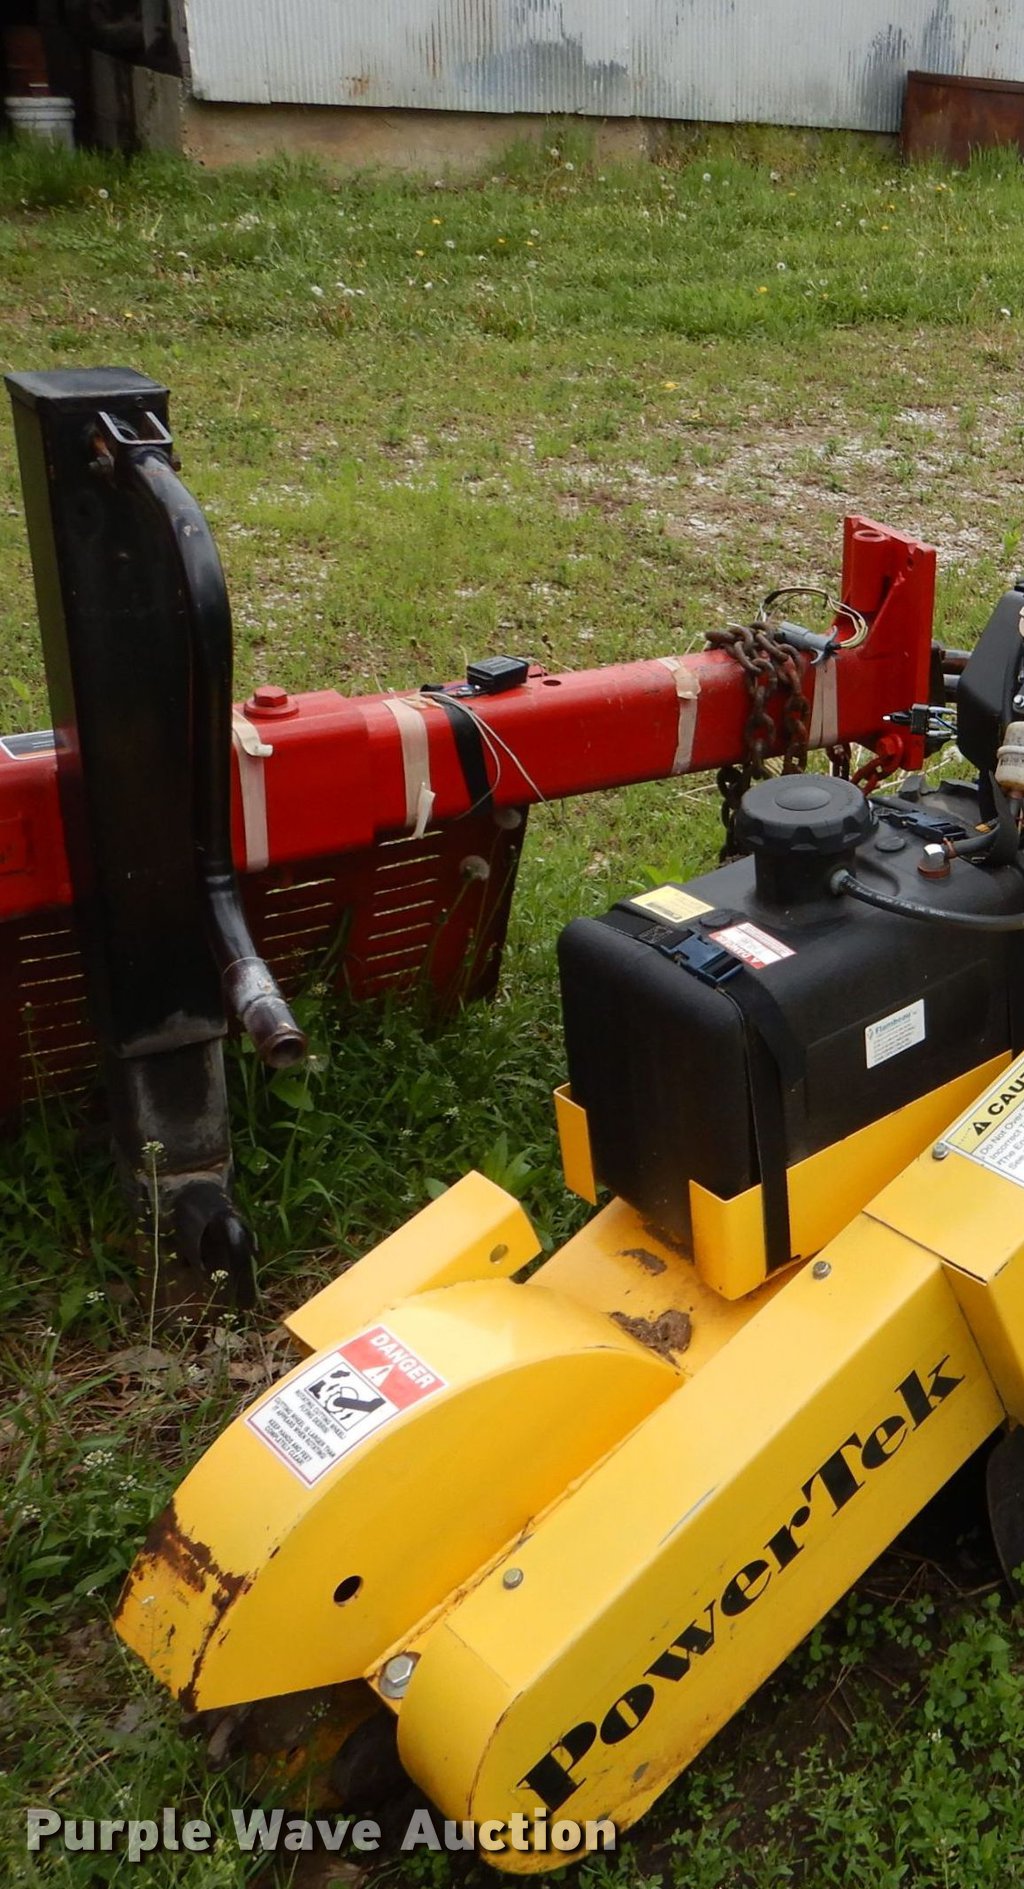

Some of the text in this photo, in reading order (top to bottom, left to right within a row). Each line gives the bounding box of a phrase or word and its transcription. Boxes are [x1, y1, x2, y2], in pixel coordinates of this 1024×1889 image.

[979, 1142, 994, 1155] Do
[989, 1129, 1007, 1144] Not
[1003, 1111, 1024, 1130] Over
[988, 1128, 1022, 1160] Incorrect
[998, 1149, 1016, 1164] The
[370, 1332, 435, 1388] DANGER
[276, 1409, 296, 1428] APPEARS
[293, 1426, 307, 1439] WHEN
[293, 1389, 315, 1409] ROTATING
[312, 1407, 332, 1425] CUTTING
[298, 1403, 315, 1419] FLYING
[263, 1425, 291, 1451] COMPLETELY
[267, 1418, 312, 1462] KEEP HANDS AND FEET
[274, 1396, 293, 1414] CUTTING
[289, 1413, 305, 1427] WHEEL
[307, 1430, 325, 1447] LARGER
[323, 1445, 336, 1457] THAN
[516, 1354, 967, 1813] PowerTek
